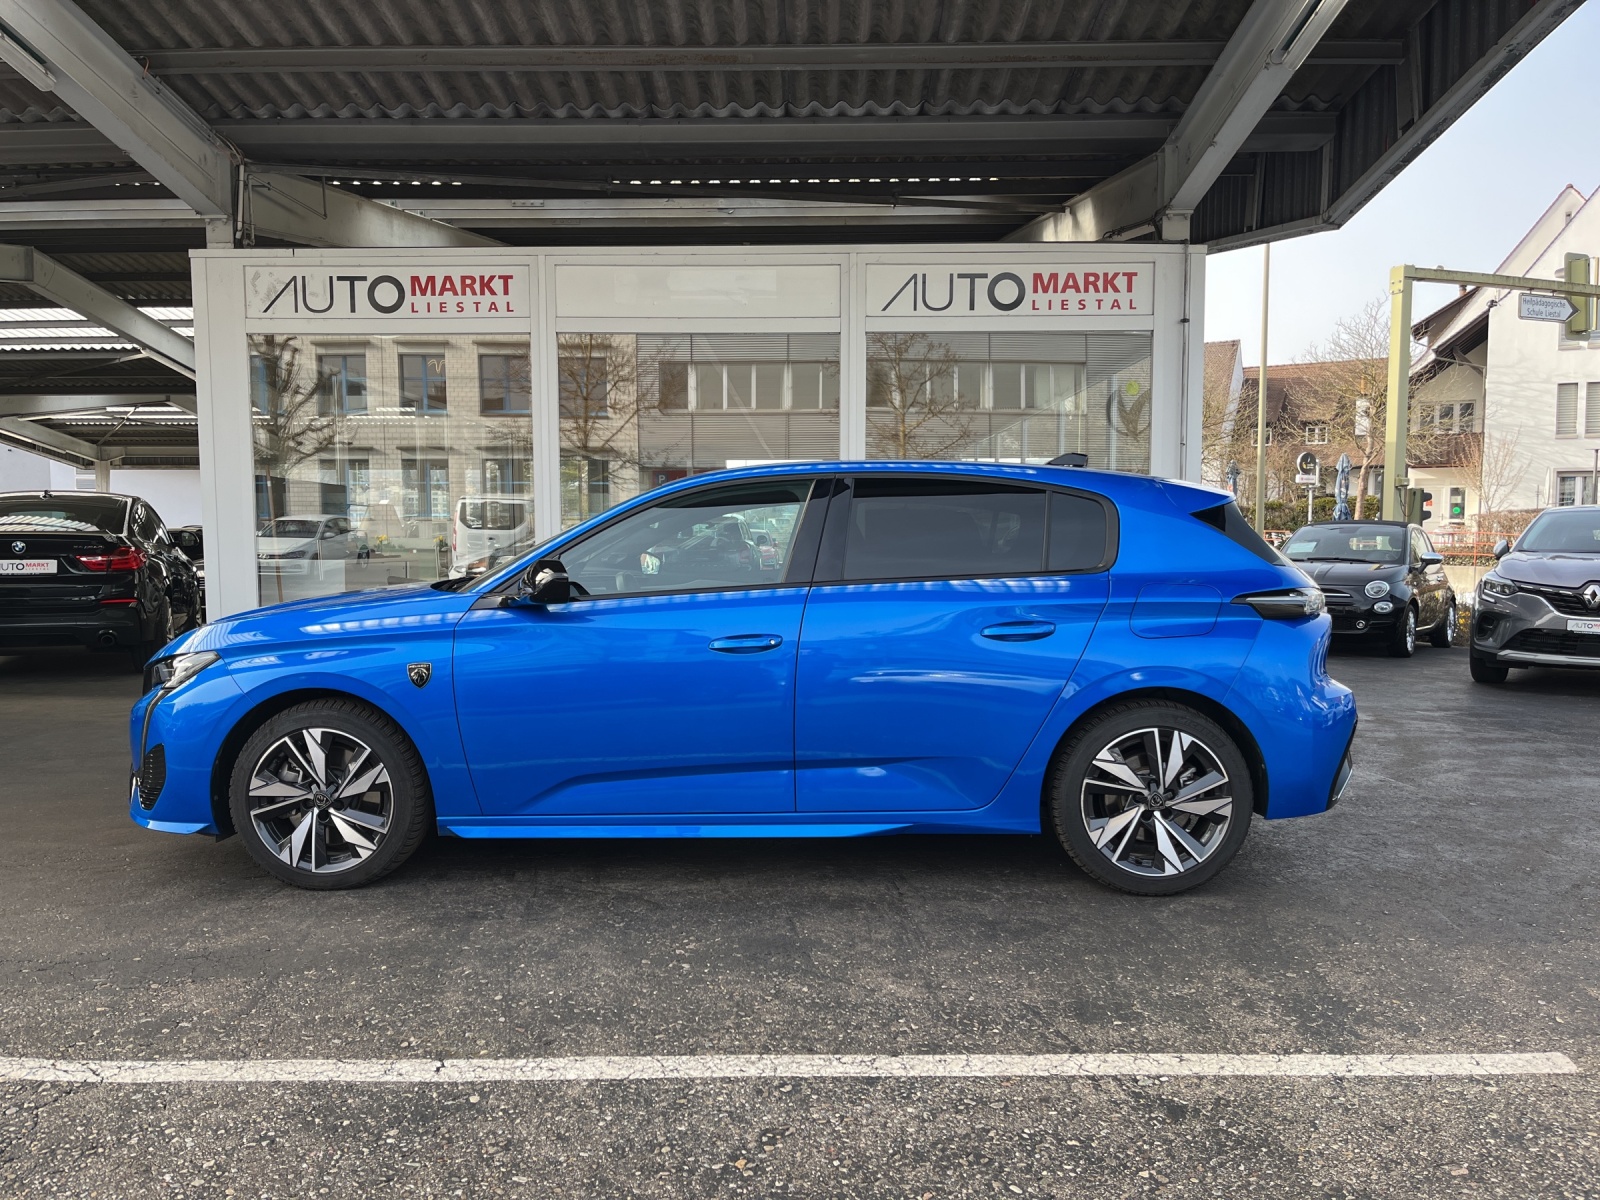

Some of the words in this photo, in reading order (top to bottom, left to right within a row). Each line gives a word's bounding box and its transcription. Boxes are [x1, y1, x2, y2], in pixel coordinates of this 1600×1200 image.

[262, 275, 405, 314] AUTO
[410, 275, 514, 297] MARKT
[881, 272, 1026, 312] AUTO
[1032, 272, 1138, 294] MARKT
[410, 301, 514, 313] LIESTAL
[1032, 299, 1137, 311] LIESTAL
[1522, 297, 1566, 309] Heilpädagogische
[1526, 308, 1544, 316] Schule
[1545, 310, 1561, 318] Liestal
[0, 562, 25, 571] UTO
